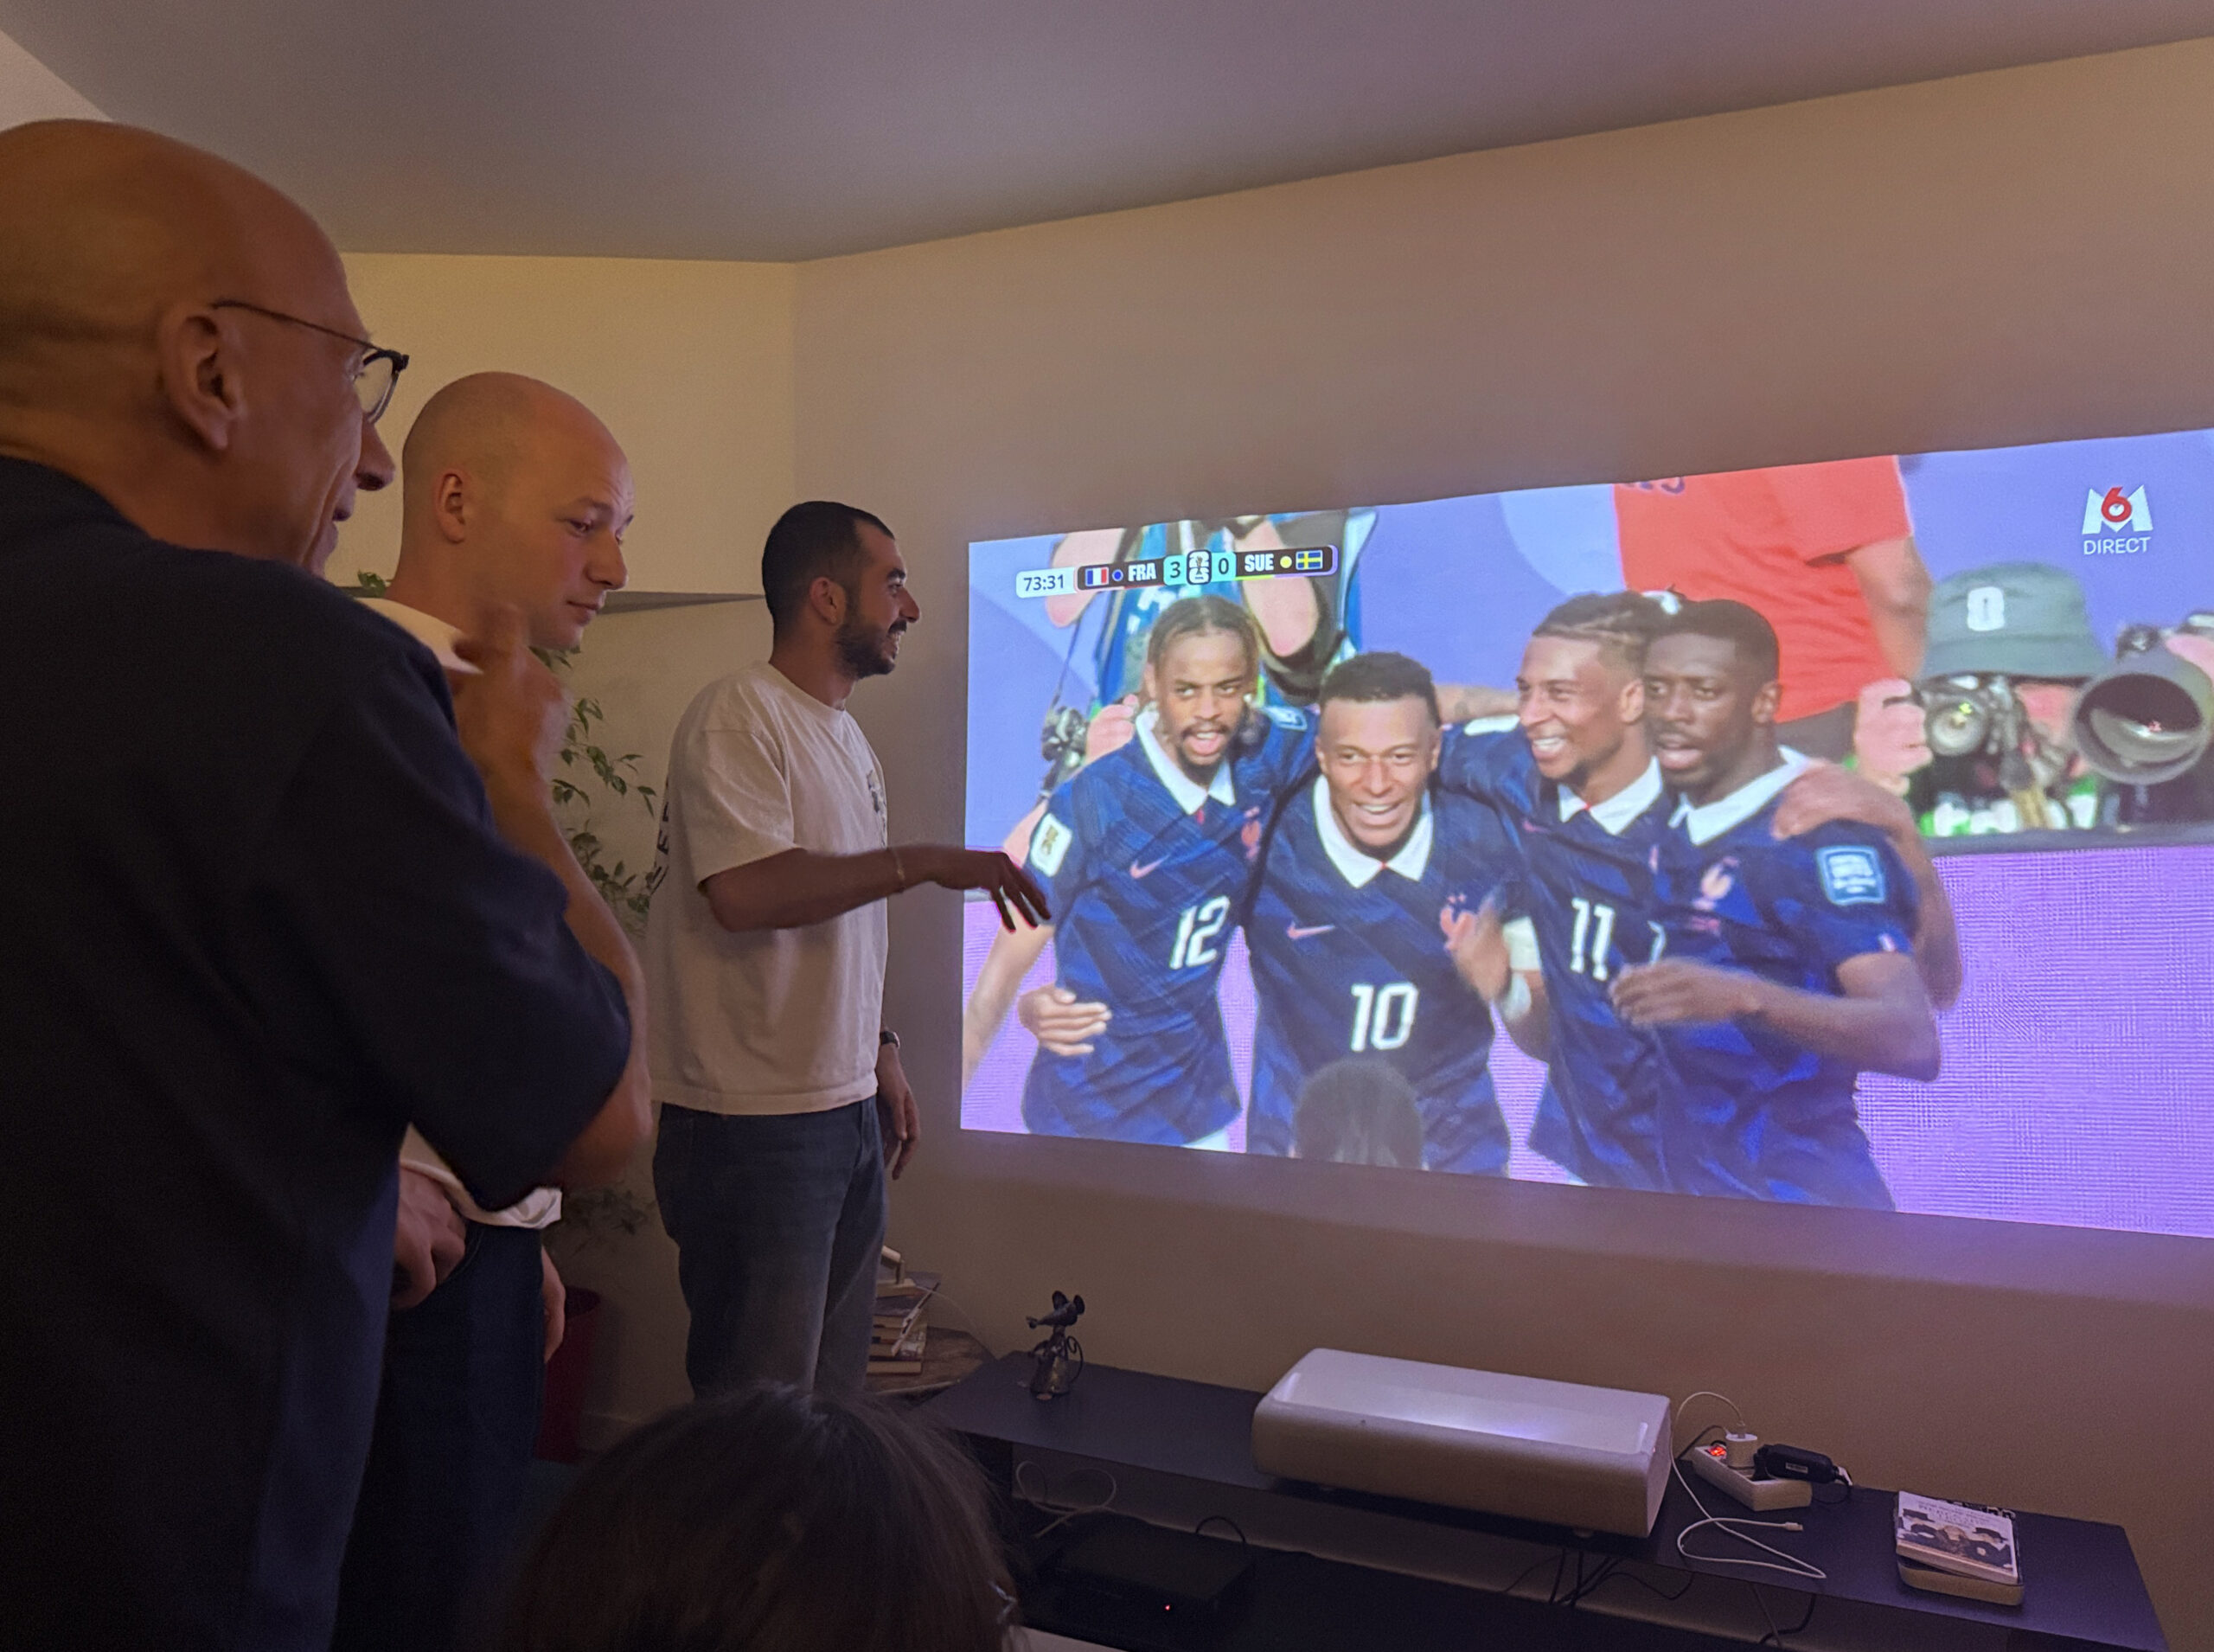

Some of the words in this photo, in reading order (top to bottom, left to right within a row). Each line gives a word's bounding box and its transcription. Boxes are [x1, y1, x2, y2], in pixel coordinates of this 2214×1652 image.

[2082, 484, 2153, 535] M6
[1023, 574, 1065, 592] 73:31
[1128, 563, 1157, 582] FRA
[1169, 560, 1181, 579] 3
[1218, 557, 1230, 575] 0
[1244, 553, 1275, 573] SUE
[2083, 536, 2152, 555] DIRECT
[1169, 895, 1230, 970] 12
[1571, 897, 1616, 981] 11
[1351, 983, 1419, 1052] 10
